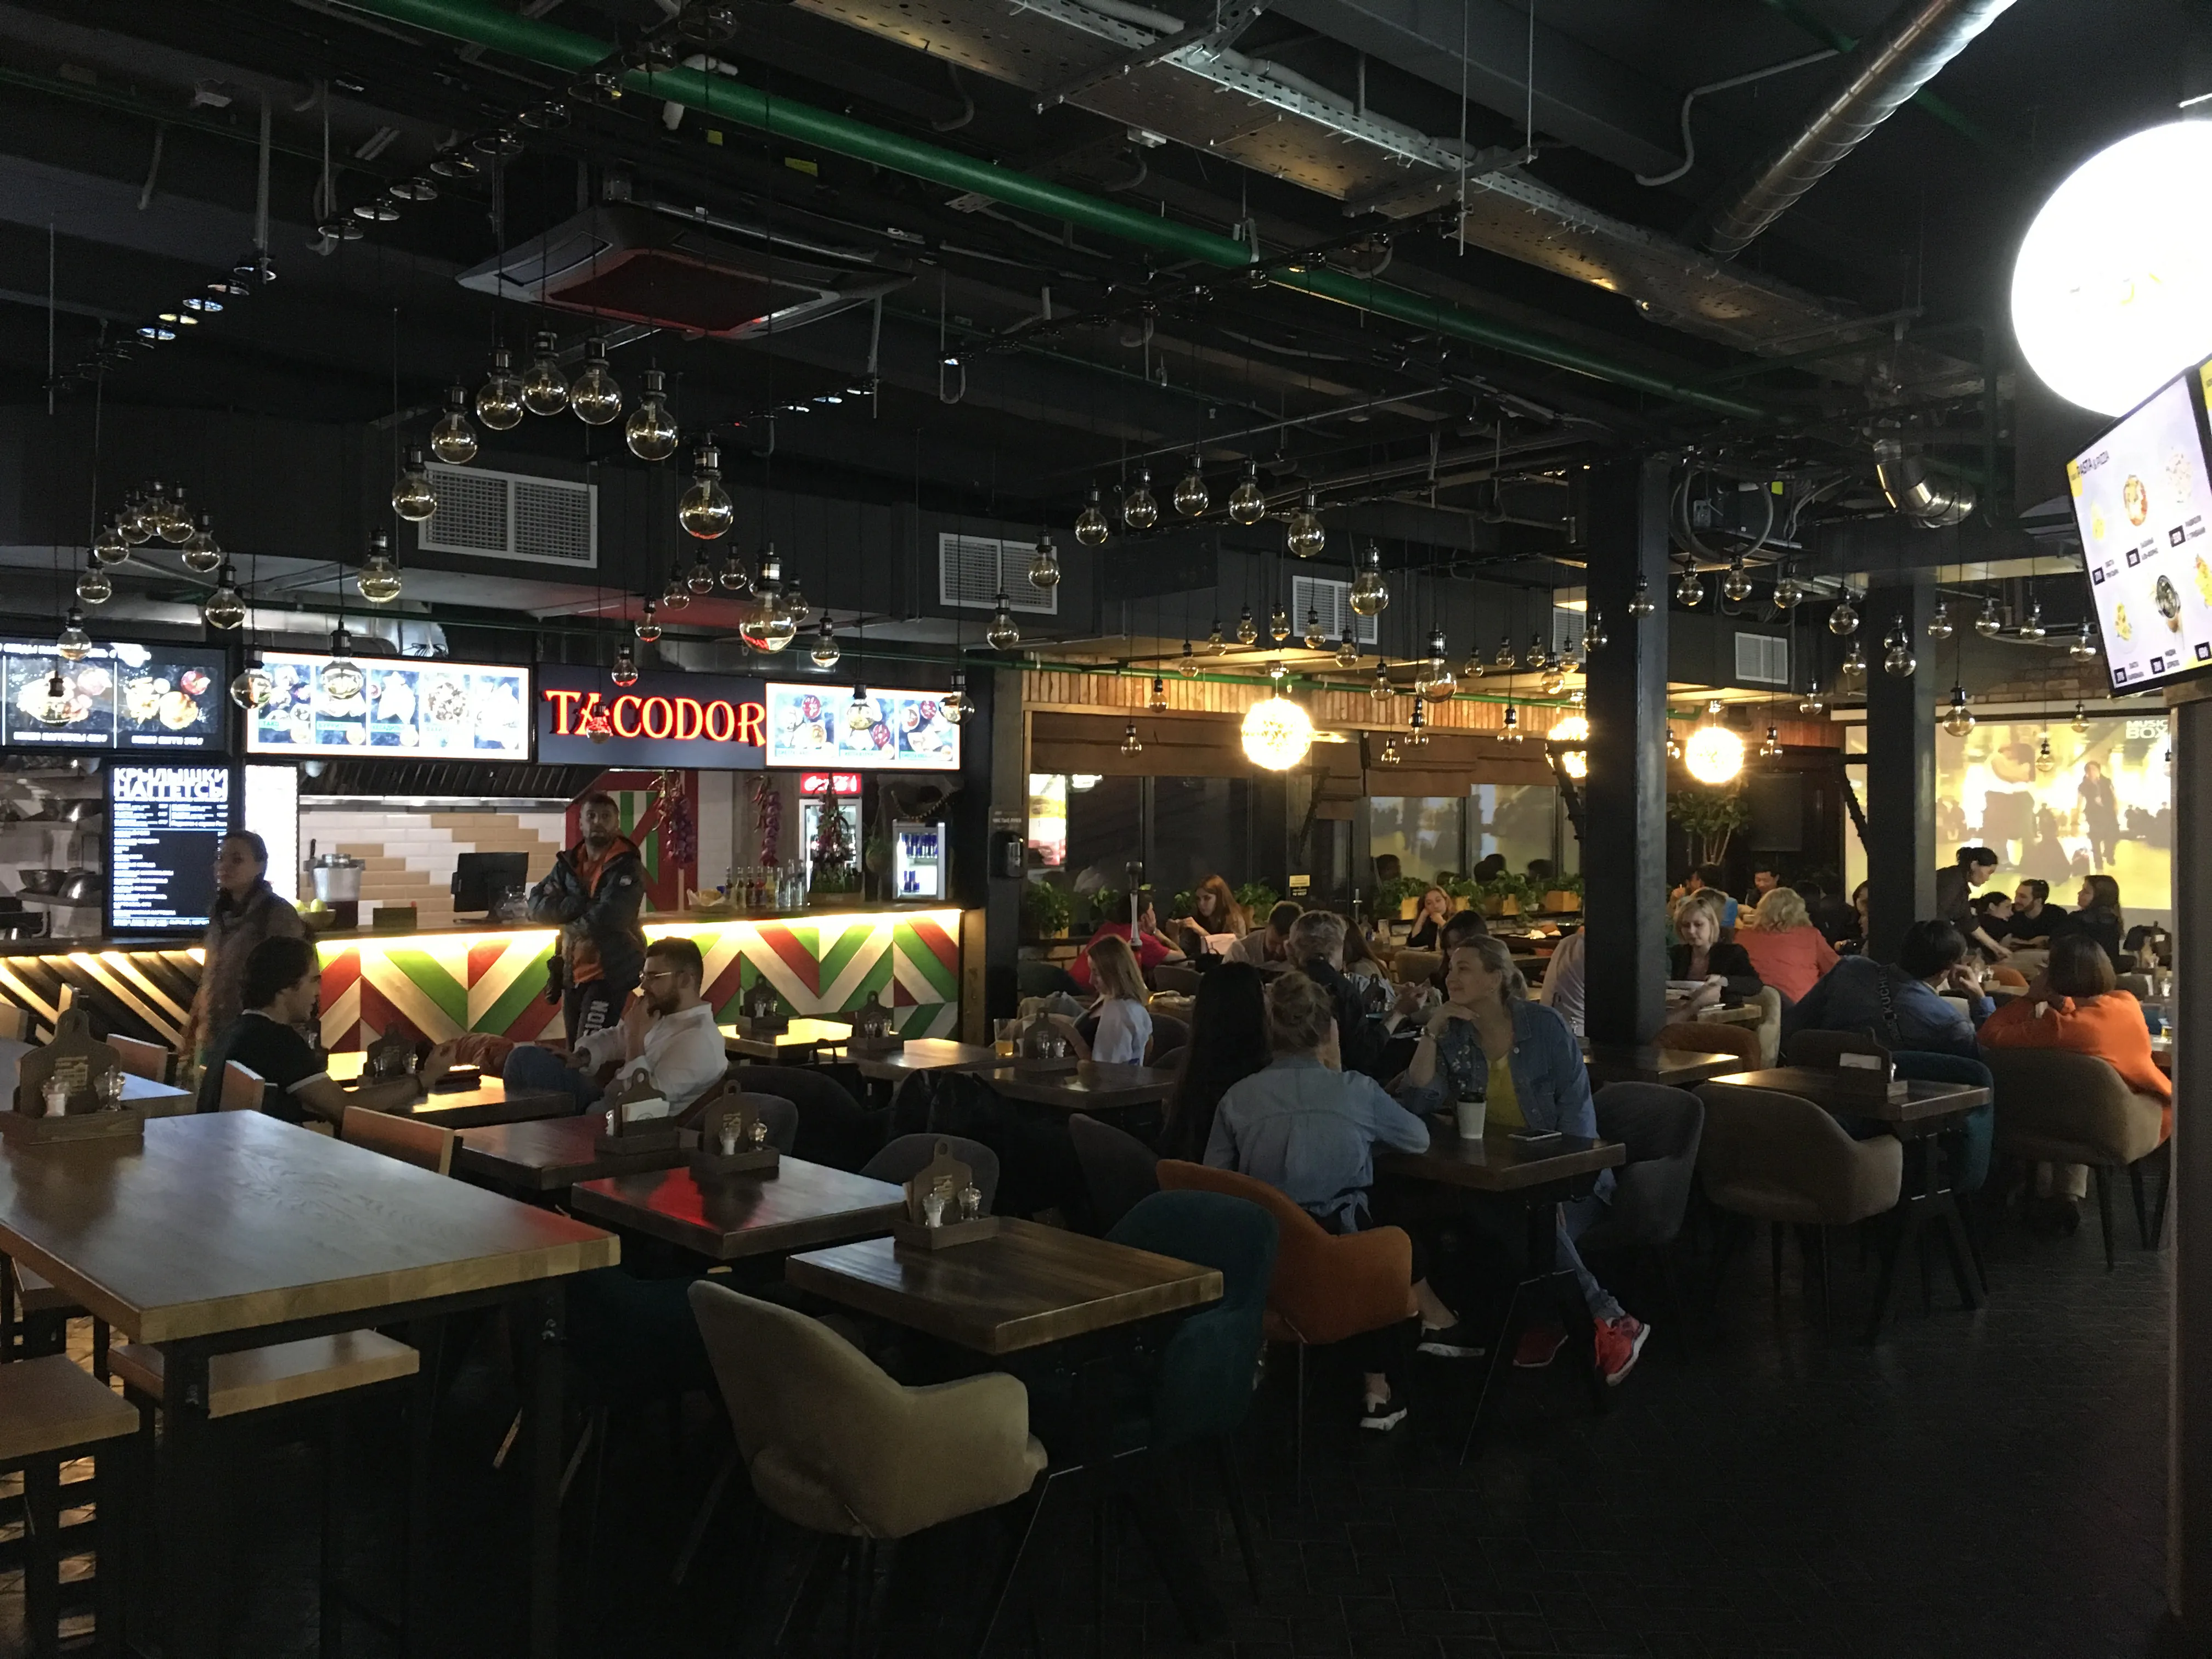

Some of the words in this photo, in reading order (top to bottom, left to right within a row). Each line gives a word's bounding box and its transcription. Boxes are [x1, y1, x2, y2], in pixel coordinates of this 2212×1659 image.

[545, 690, 766, 748] TACODOR
[2126, 720, 2169, 728] MUSIC
[2125, 727, 2169, 739] BOX
[114, 768, 228, 783] КРЫЛЫШКИ
[114, 781, 228, 798] НАГГЕТСЫ
